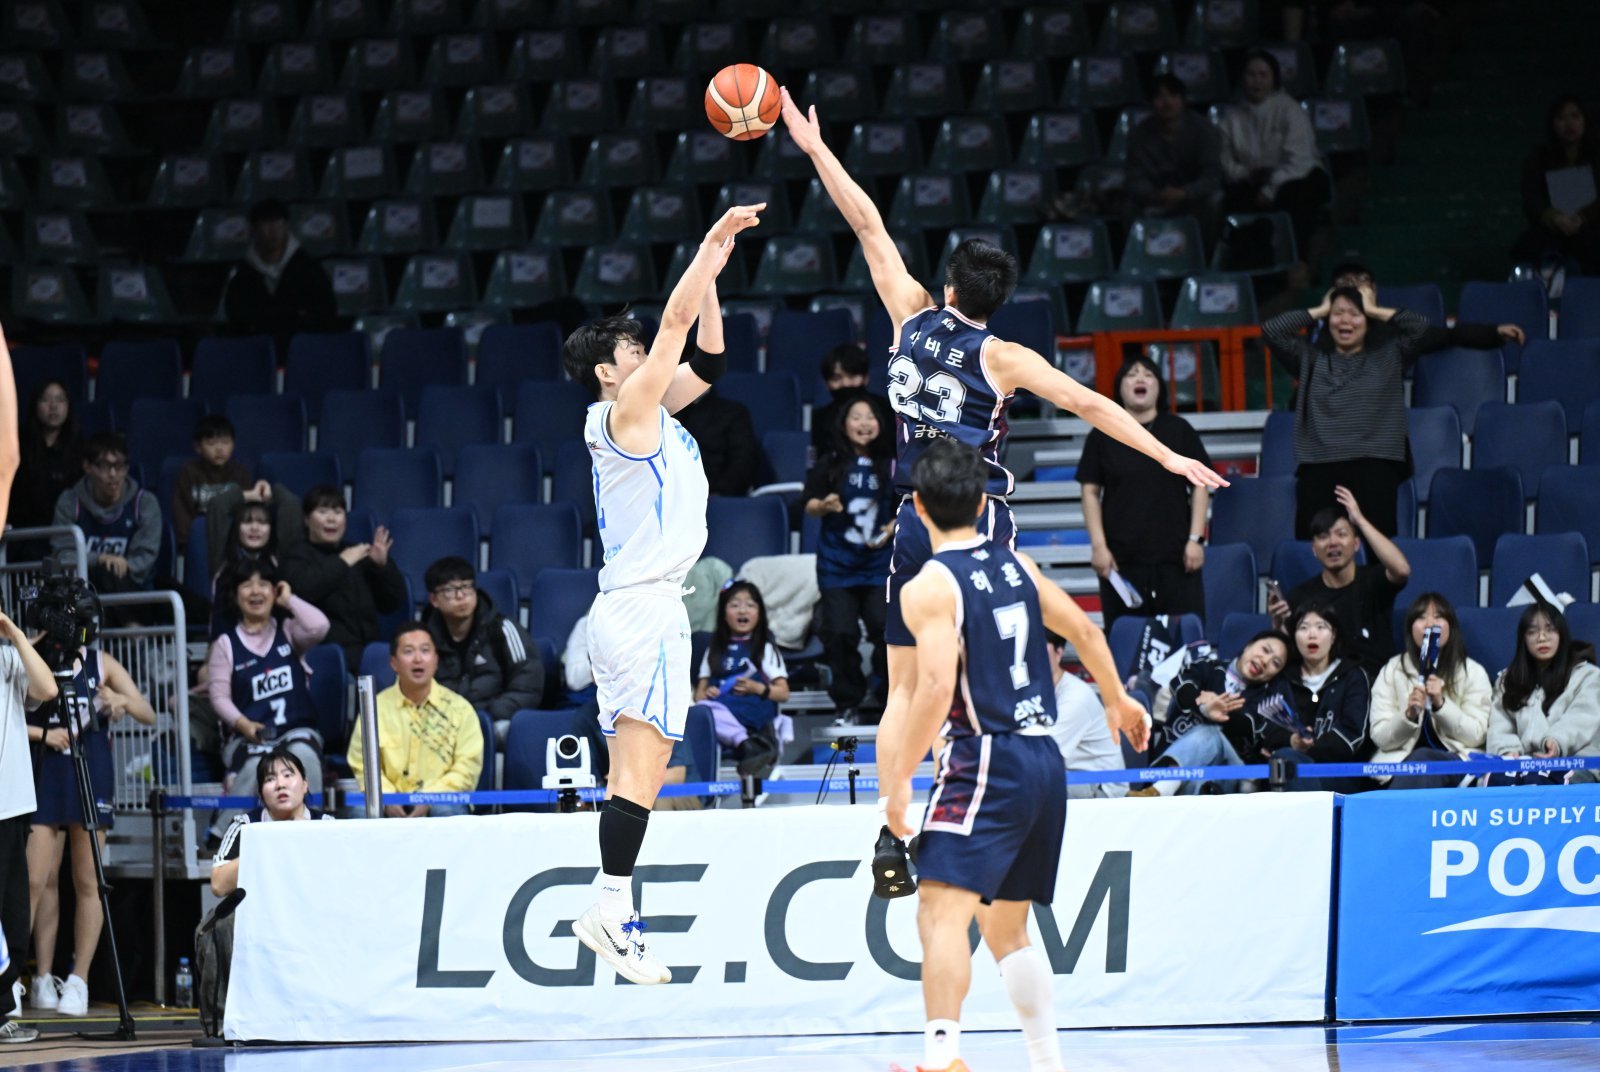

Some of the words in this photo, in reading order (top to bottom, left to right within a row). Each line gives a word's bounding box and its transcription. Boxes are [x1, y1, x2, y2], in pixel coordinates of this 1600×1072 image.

[887, 355, 968, 424] 23
[992, 601, 1030, 690] 7
[256, 671, 289, 695] KCC
[270, 697, 287, 726] 7
[1431, 809, 1478, 828] ION
[1488, 805, 1586, 827] SUPPLY
[1429, 835, 1600, 899] POC
